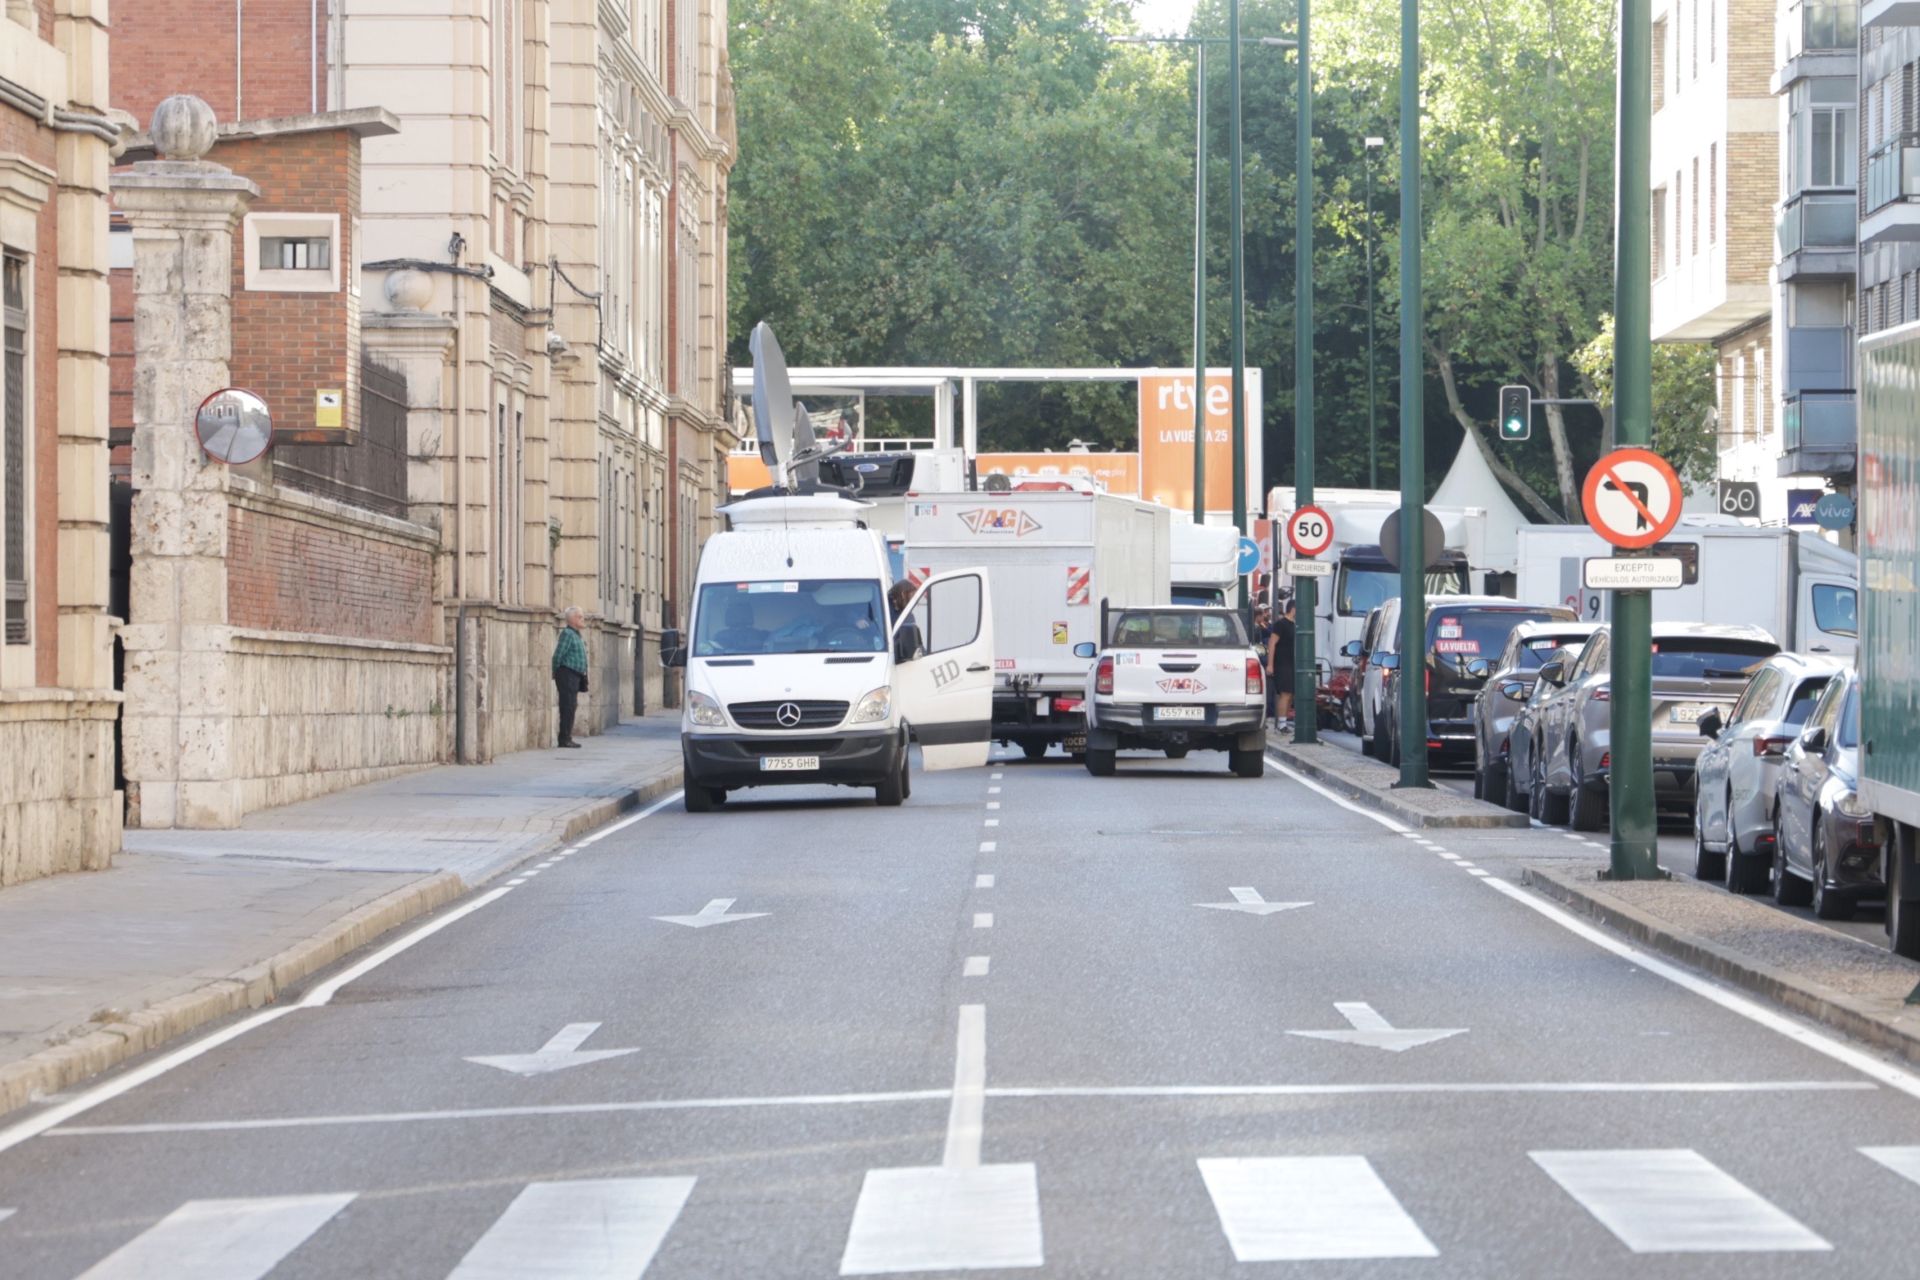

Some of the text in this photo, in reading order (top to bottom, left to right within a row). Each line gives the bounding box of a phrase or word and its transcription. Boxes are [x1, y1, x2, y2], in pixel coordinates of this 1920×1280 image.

[1160, 430, 1228, 443] LA VUEA 25
[1722, 488, 1756, 512] 60
[1820, 503, 1851, 518] vive
[982, 509, 1017, 528] A&G
[1298, 521, 1323, 538] 50
[1292, 563, 1326, 572] RECUERDE
[1614, 563, 1655, 573] EXCEPTO
[1631, 575, 1680, 584] AUTORIZADOS
[1440, 643, 1477, 651] LA VUELTA
[930, 659, 961, 689] HD
[1160, 708, 1203, 717] 4557 KKR
[767, 757, 817, 769] 7755 GHR
